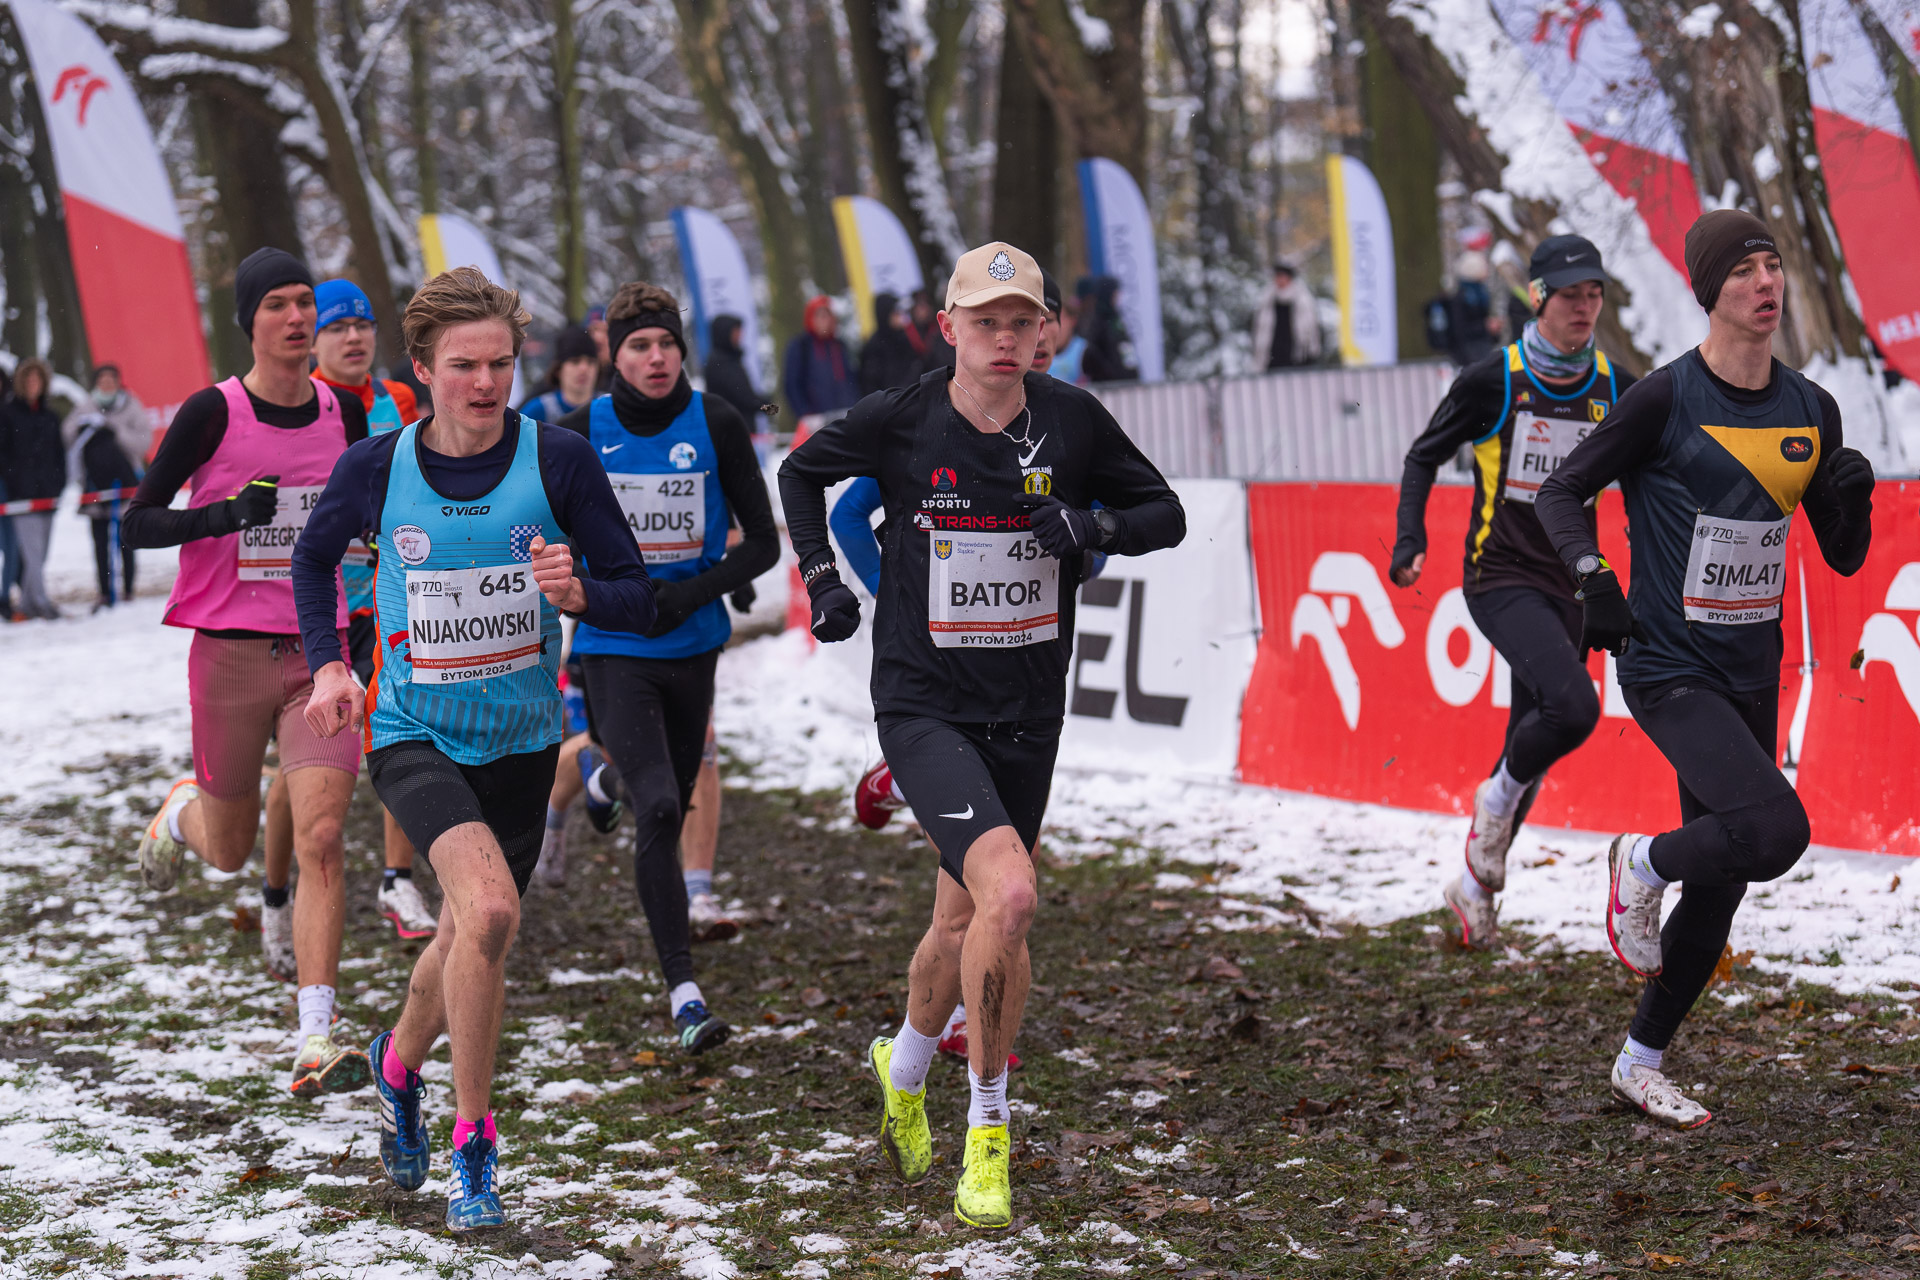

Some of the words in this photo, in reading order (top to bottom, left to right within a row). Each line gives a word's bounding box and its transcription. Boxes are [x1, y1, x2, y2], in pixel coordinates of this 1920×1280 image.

[1522, 453, 1568, 473] FILI
[658, 479, 695, 497] 422
[301, 492, 323, 511] 18
[921, 499, 971, 509] SPORTU
[1712, 526, 1734, 540] 770
[479, 571, 527, 596] 645
[1702, 562, 1781, 588] SIMLAT
[421, 581, 443, 592] 770
[951, 579, 1041, 607] BATOR
[1707, 611, 1743, 622] BYTOM
[1743, 611, 1764, 621] 2024
[412, 609, 535, 645] NIJAKOWSKI
[961, 635, 1004, 645] BYTOM
[1007, 632, 1033, 645] 2024
[434, 659, 465, 667] Mistrzostwa
[441, 668, 483, 681] BYTOM
[485, 663, 512, 676] 2024
